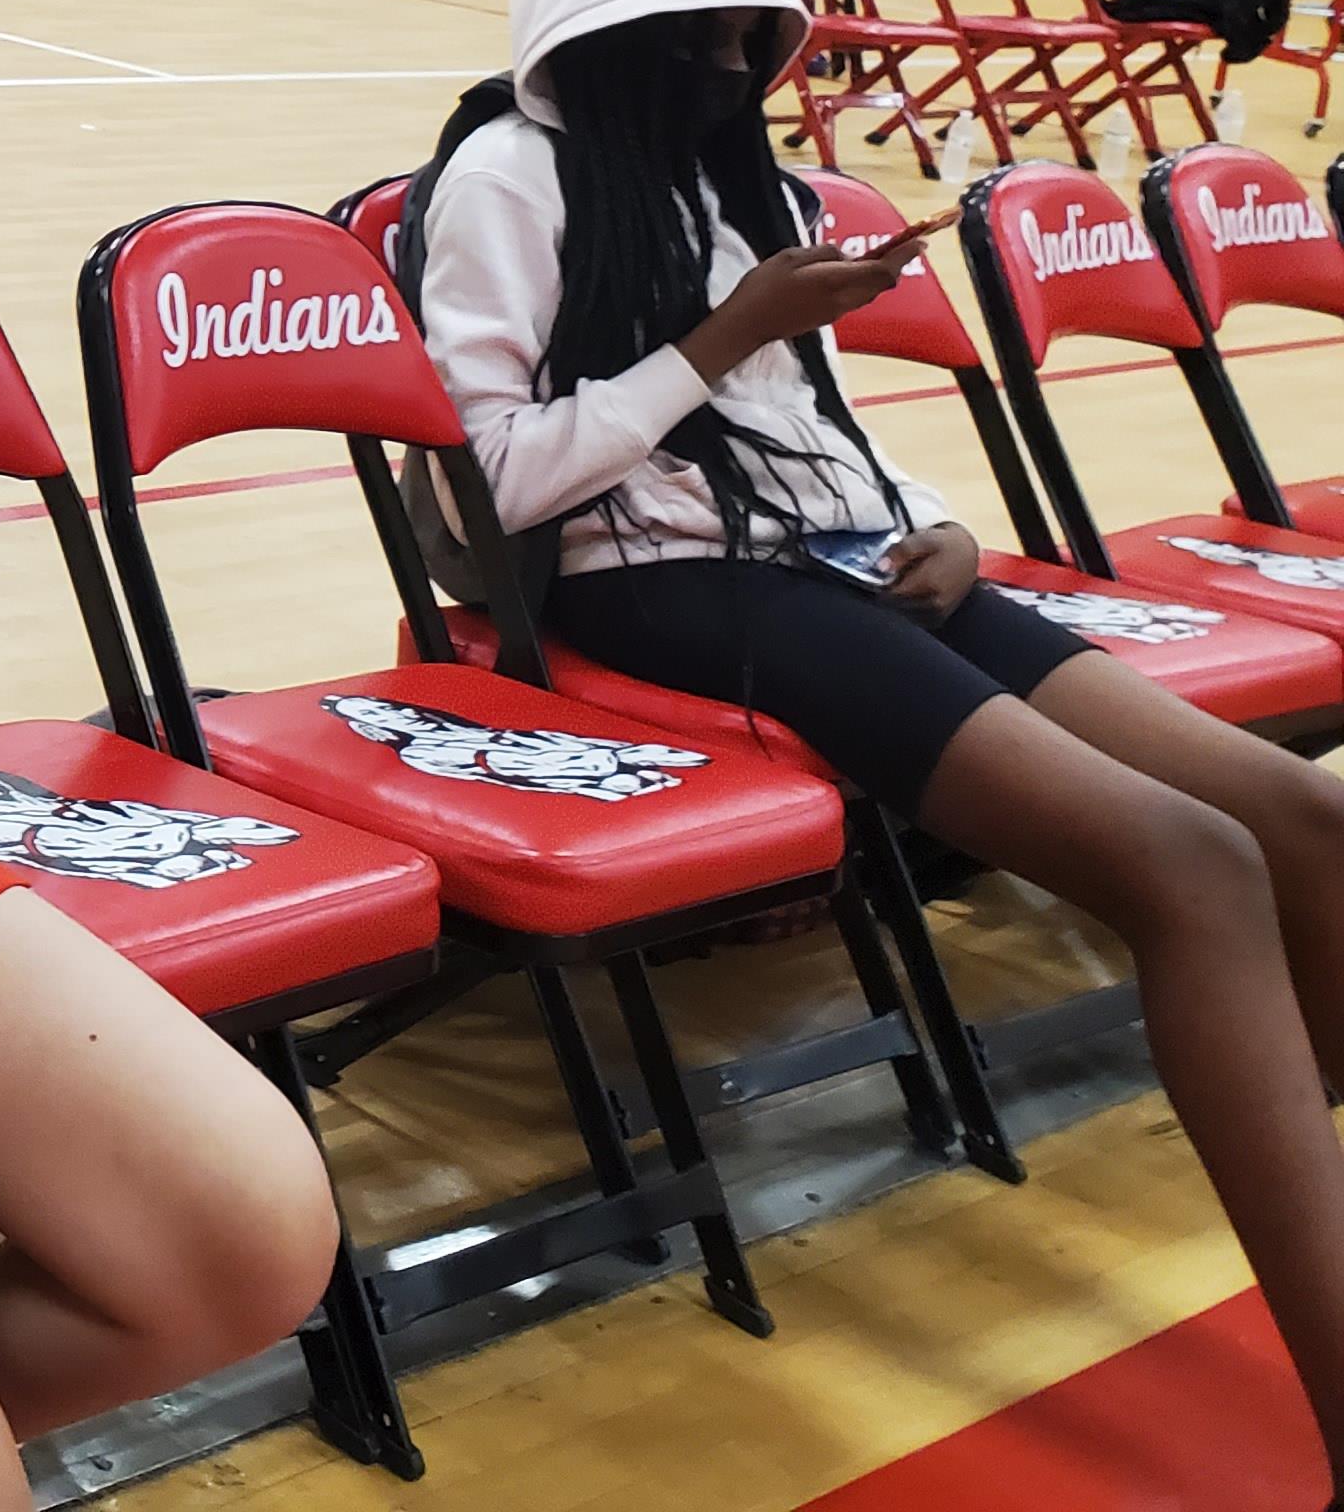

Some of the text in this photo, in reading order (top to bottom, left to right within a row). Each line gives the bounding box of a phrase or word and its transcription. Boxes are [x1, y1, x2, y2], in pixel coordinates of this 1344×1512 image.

[1019, 203, 1155, 283] Indians
[1197, 183, 1330, 254] Indians
[156, 266, 401, 370] Indians
